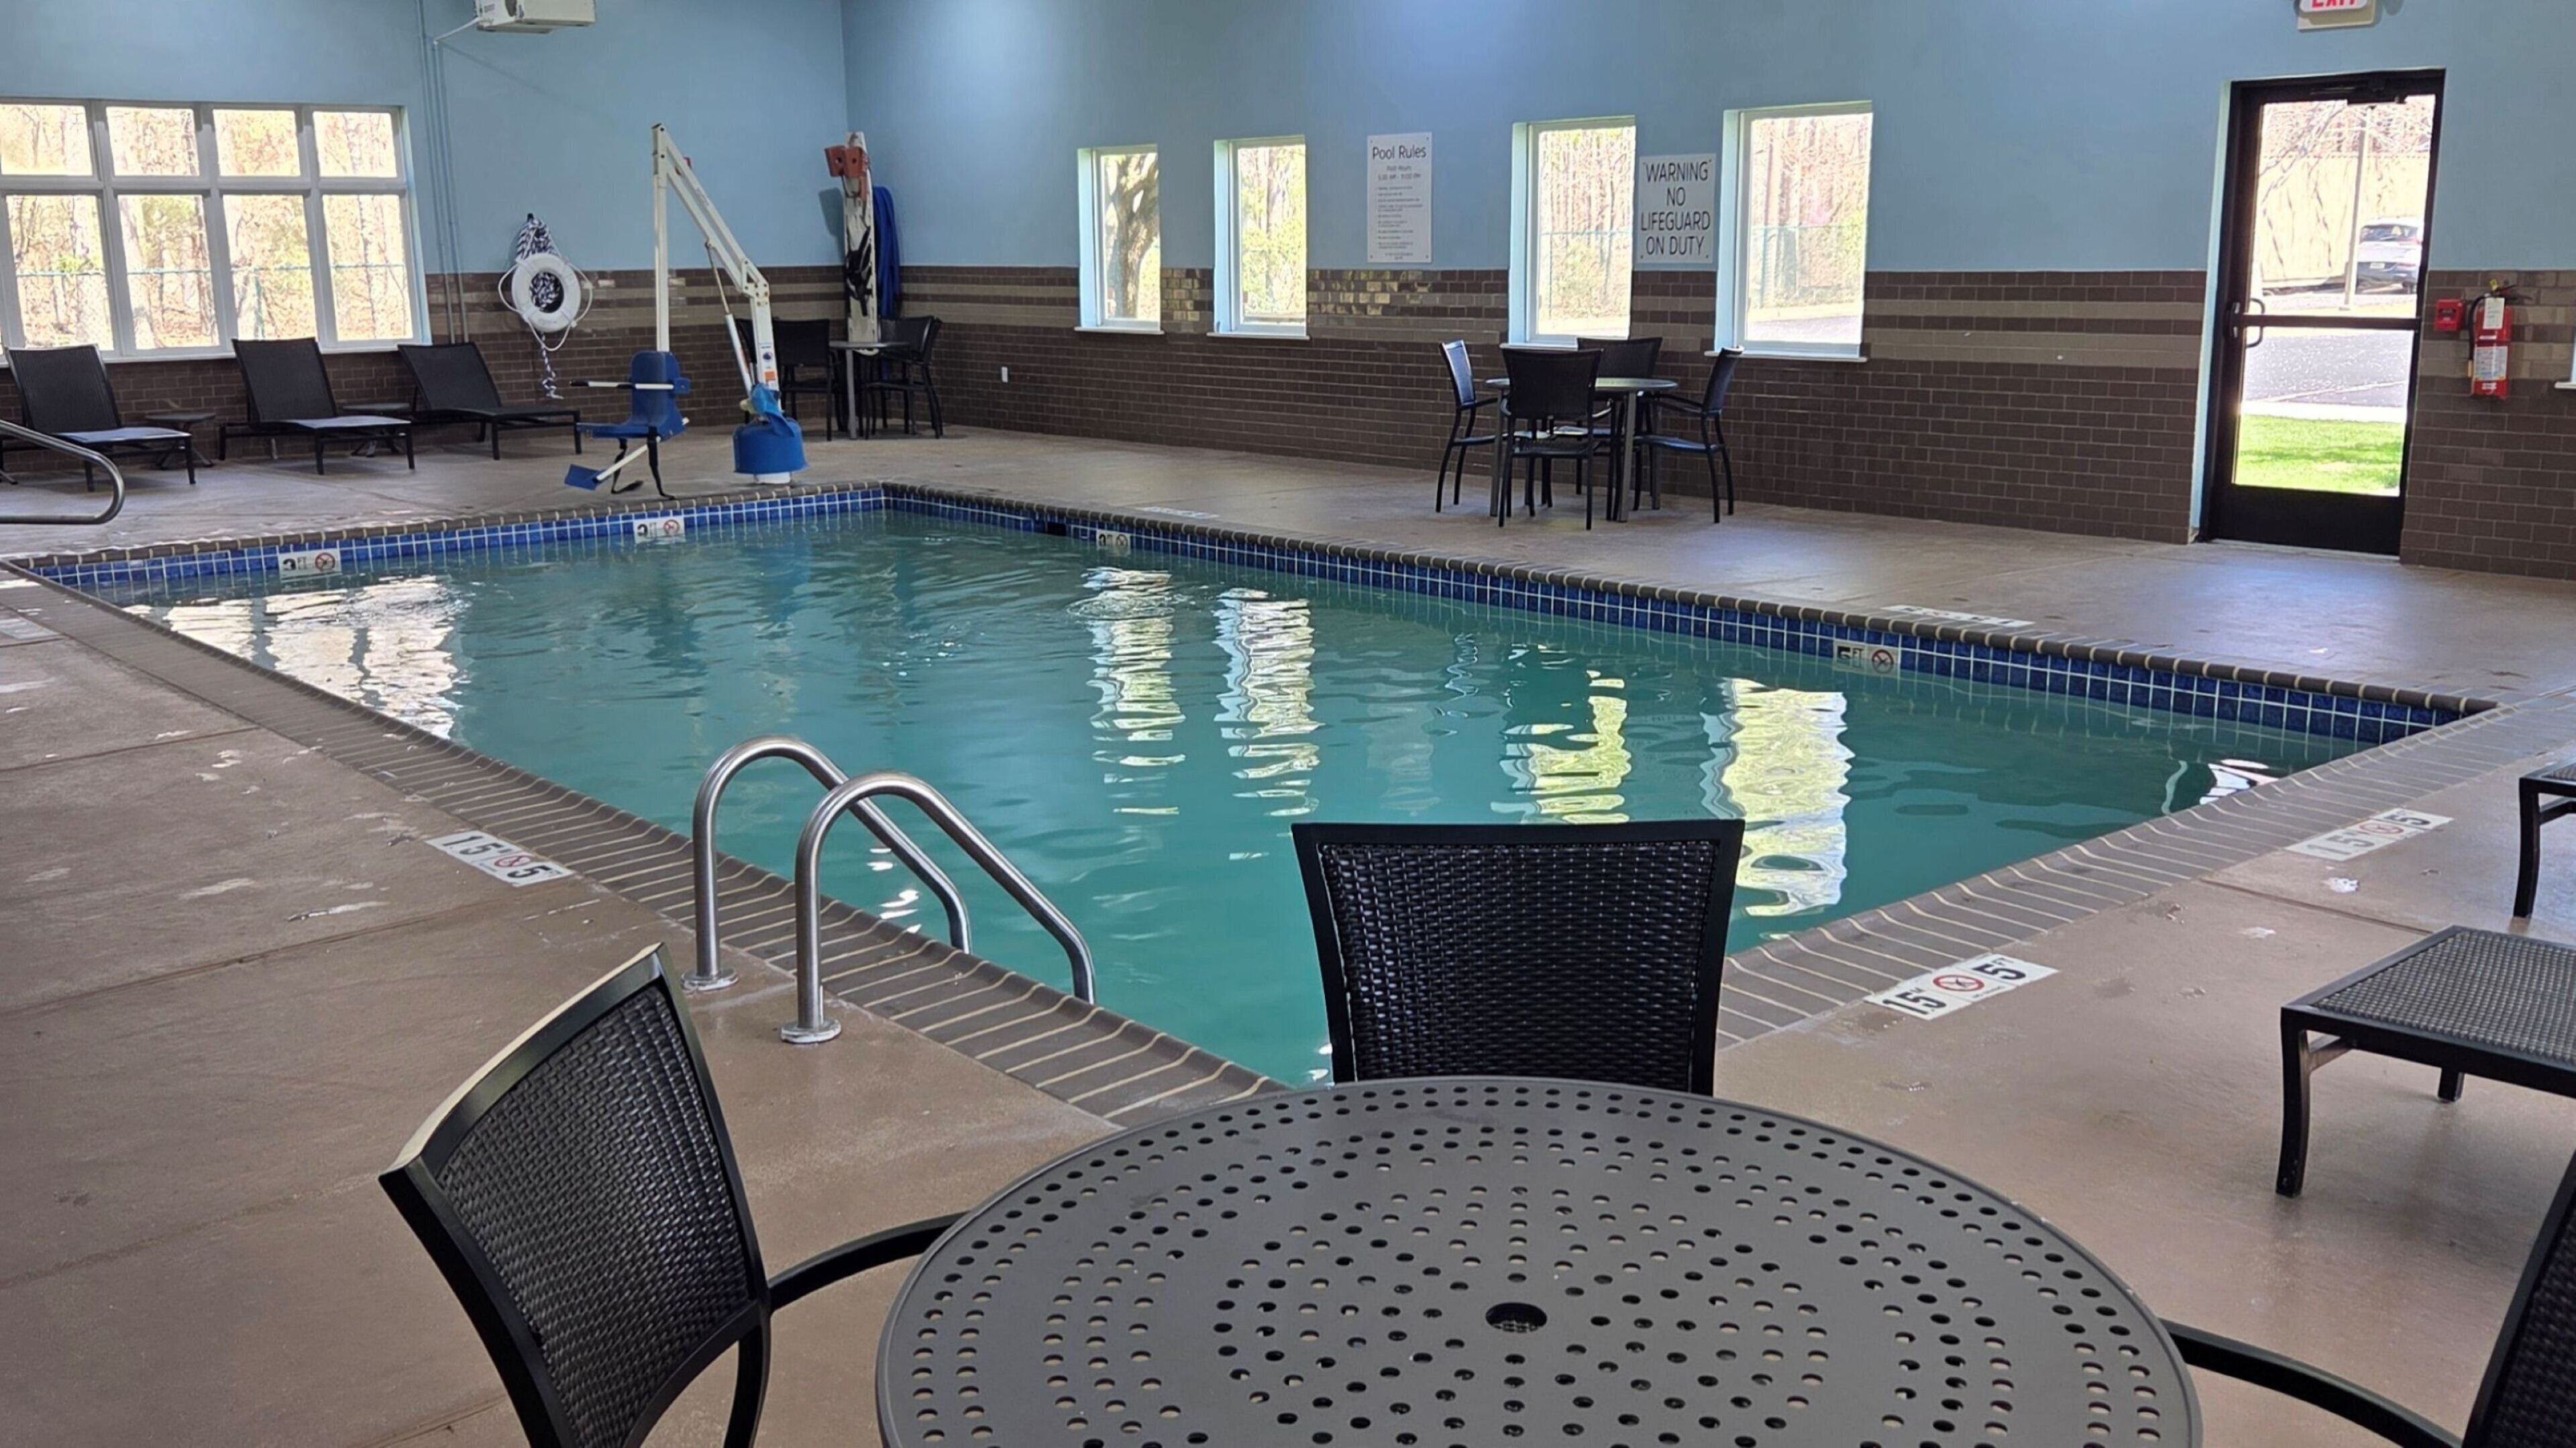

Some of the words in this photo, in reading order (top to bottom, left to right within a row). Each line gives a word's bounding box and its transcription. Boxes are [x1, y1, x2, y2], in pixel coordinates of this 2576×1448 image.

[1373, 145, 1395, 160] Pool
[1398, 144, 1427, 159] Rules
[1646, 161, 1709, 183] WARNING
[1666, 187, 1686, 207] NO
[1640, 211, 1711, 231] LIFEGUARD
[1646, 236, 1664, 256] ON
[1669, 236, 1705, 256] DUTY
